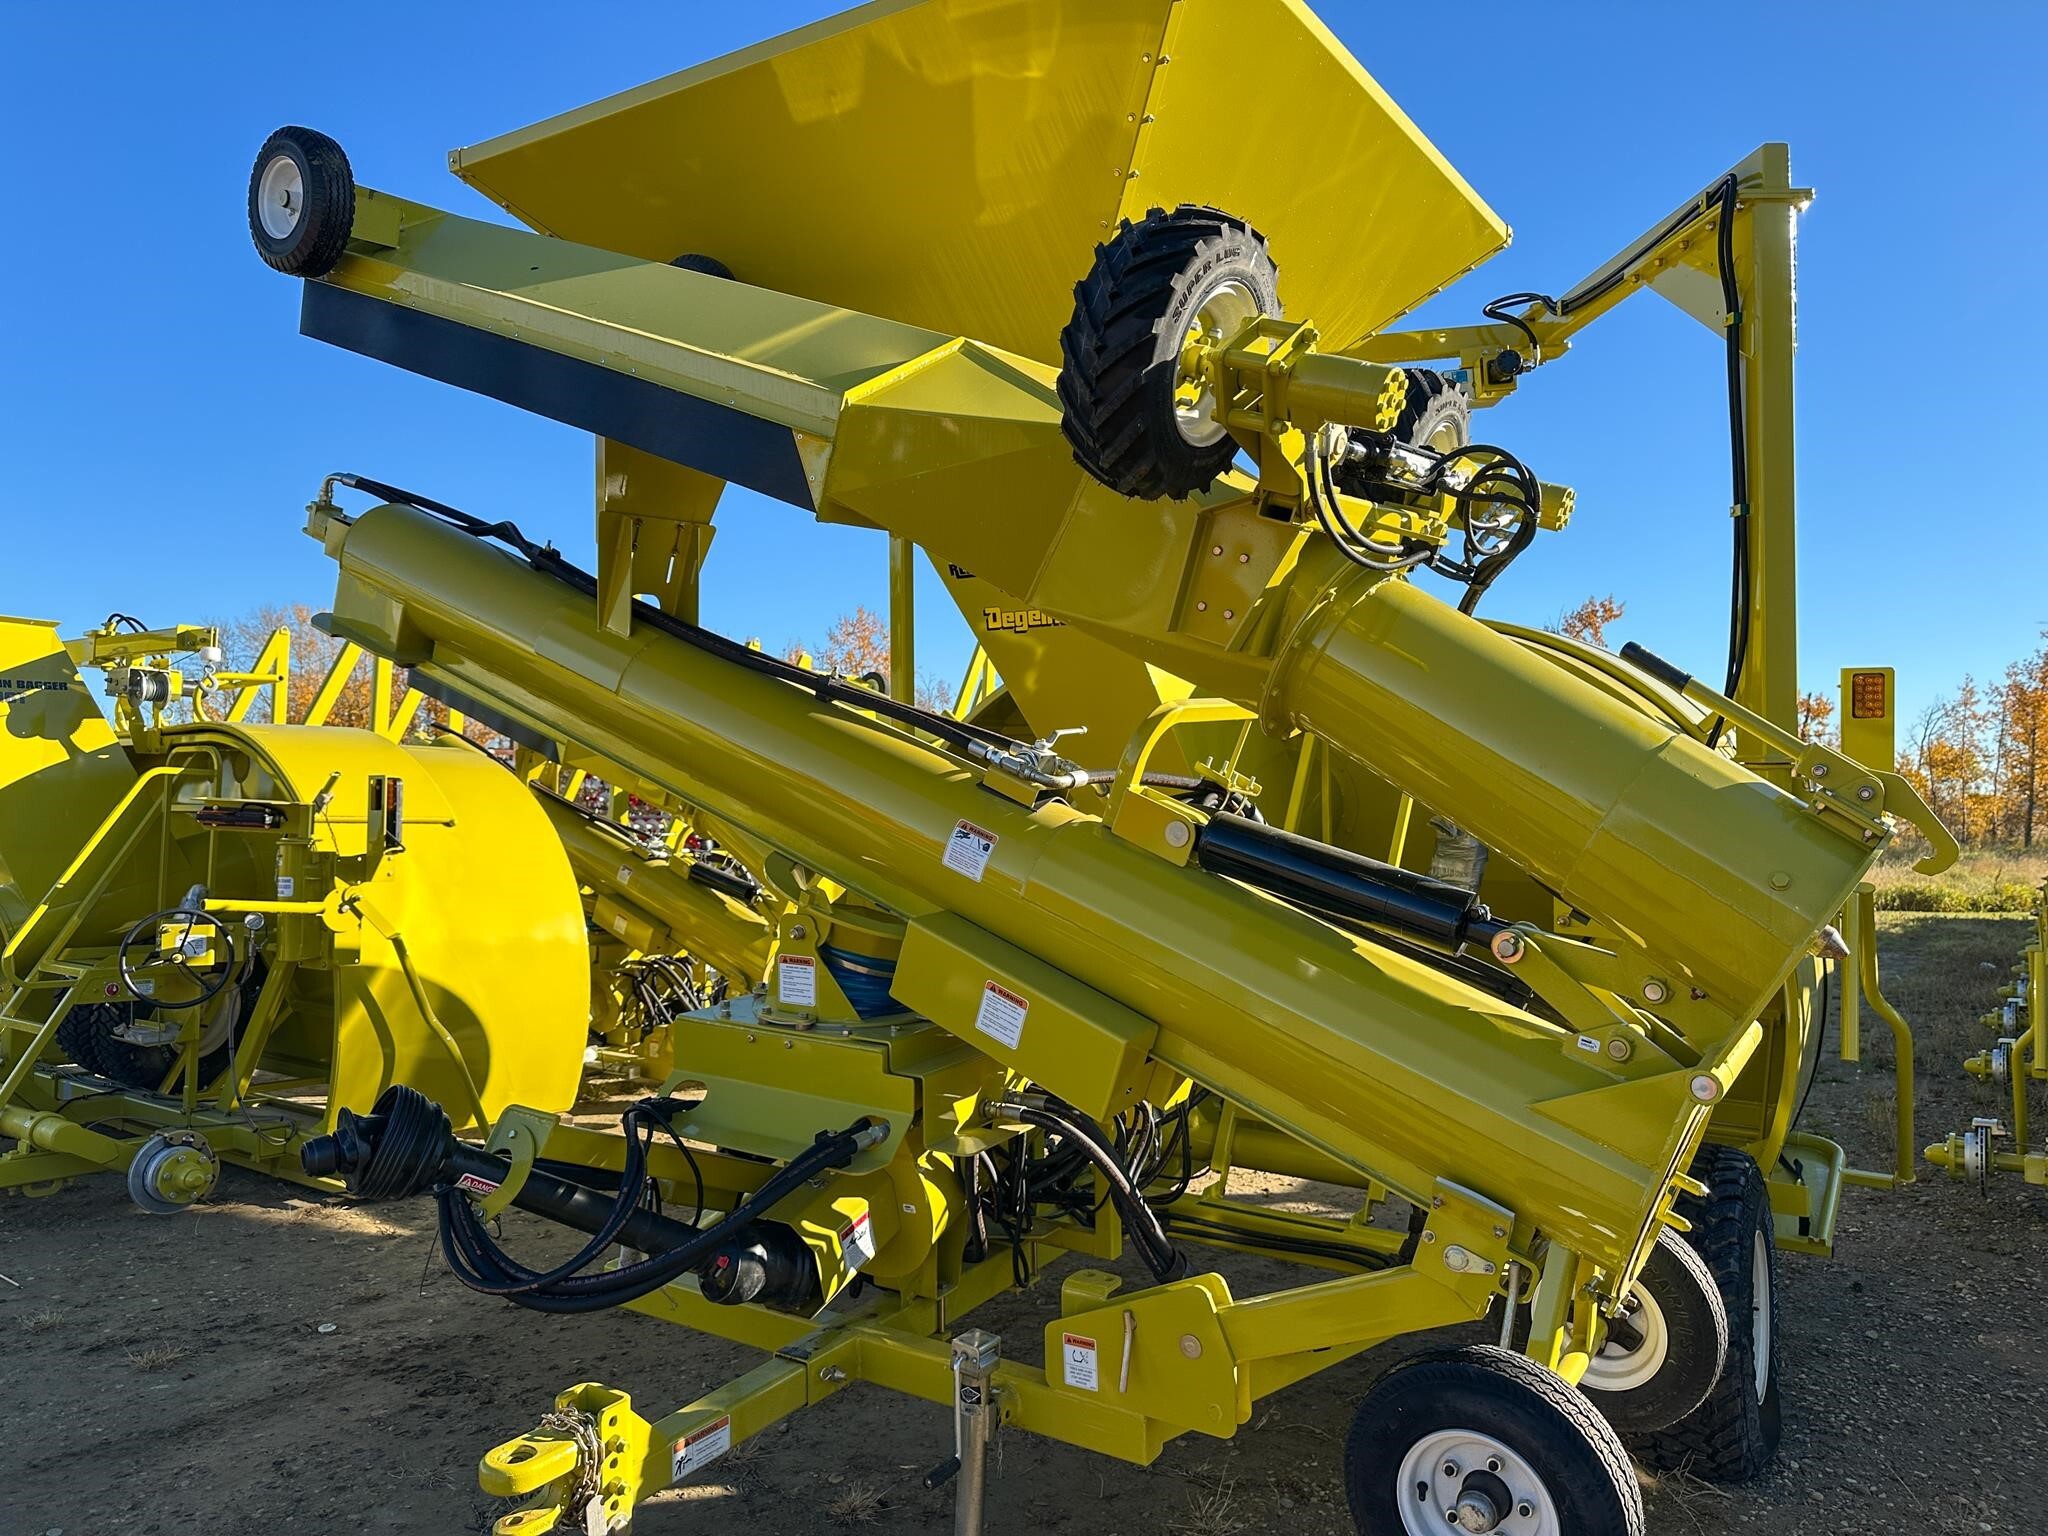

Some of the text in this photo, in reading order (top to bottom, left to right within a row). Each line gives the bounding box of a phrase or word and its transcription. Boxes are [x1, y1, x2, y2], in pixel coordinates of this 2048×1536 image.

[1172, 247, 1241, 324] SUPER LUG
[16, 680, 69, 691] BAGGER
[968, 826, 994, 842] WARNING
[998, 988, 1023, 1007] WARNING
[471, 1181, 497, 1193] DANG
[1072, 1338, 1095, 1348] WARNING
